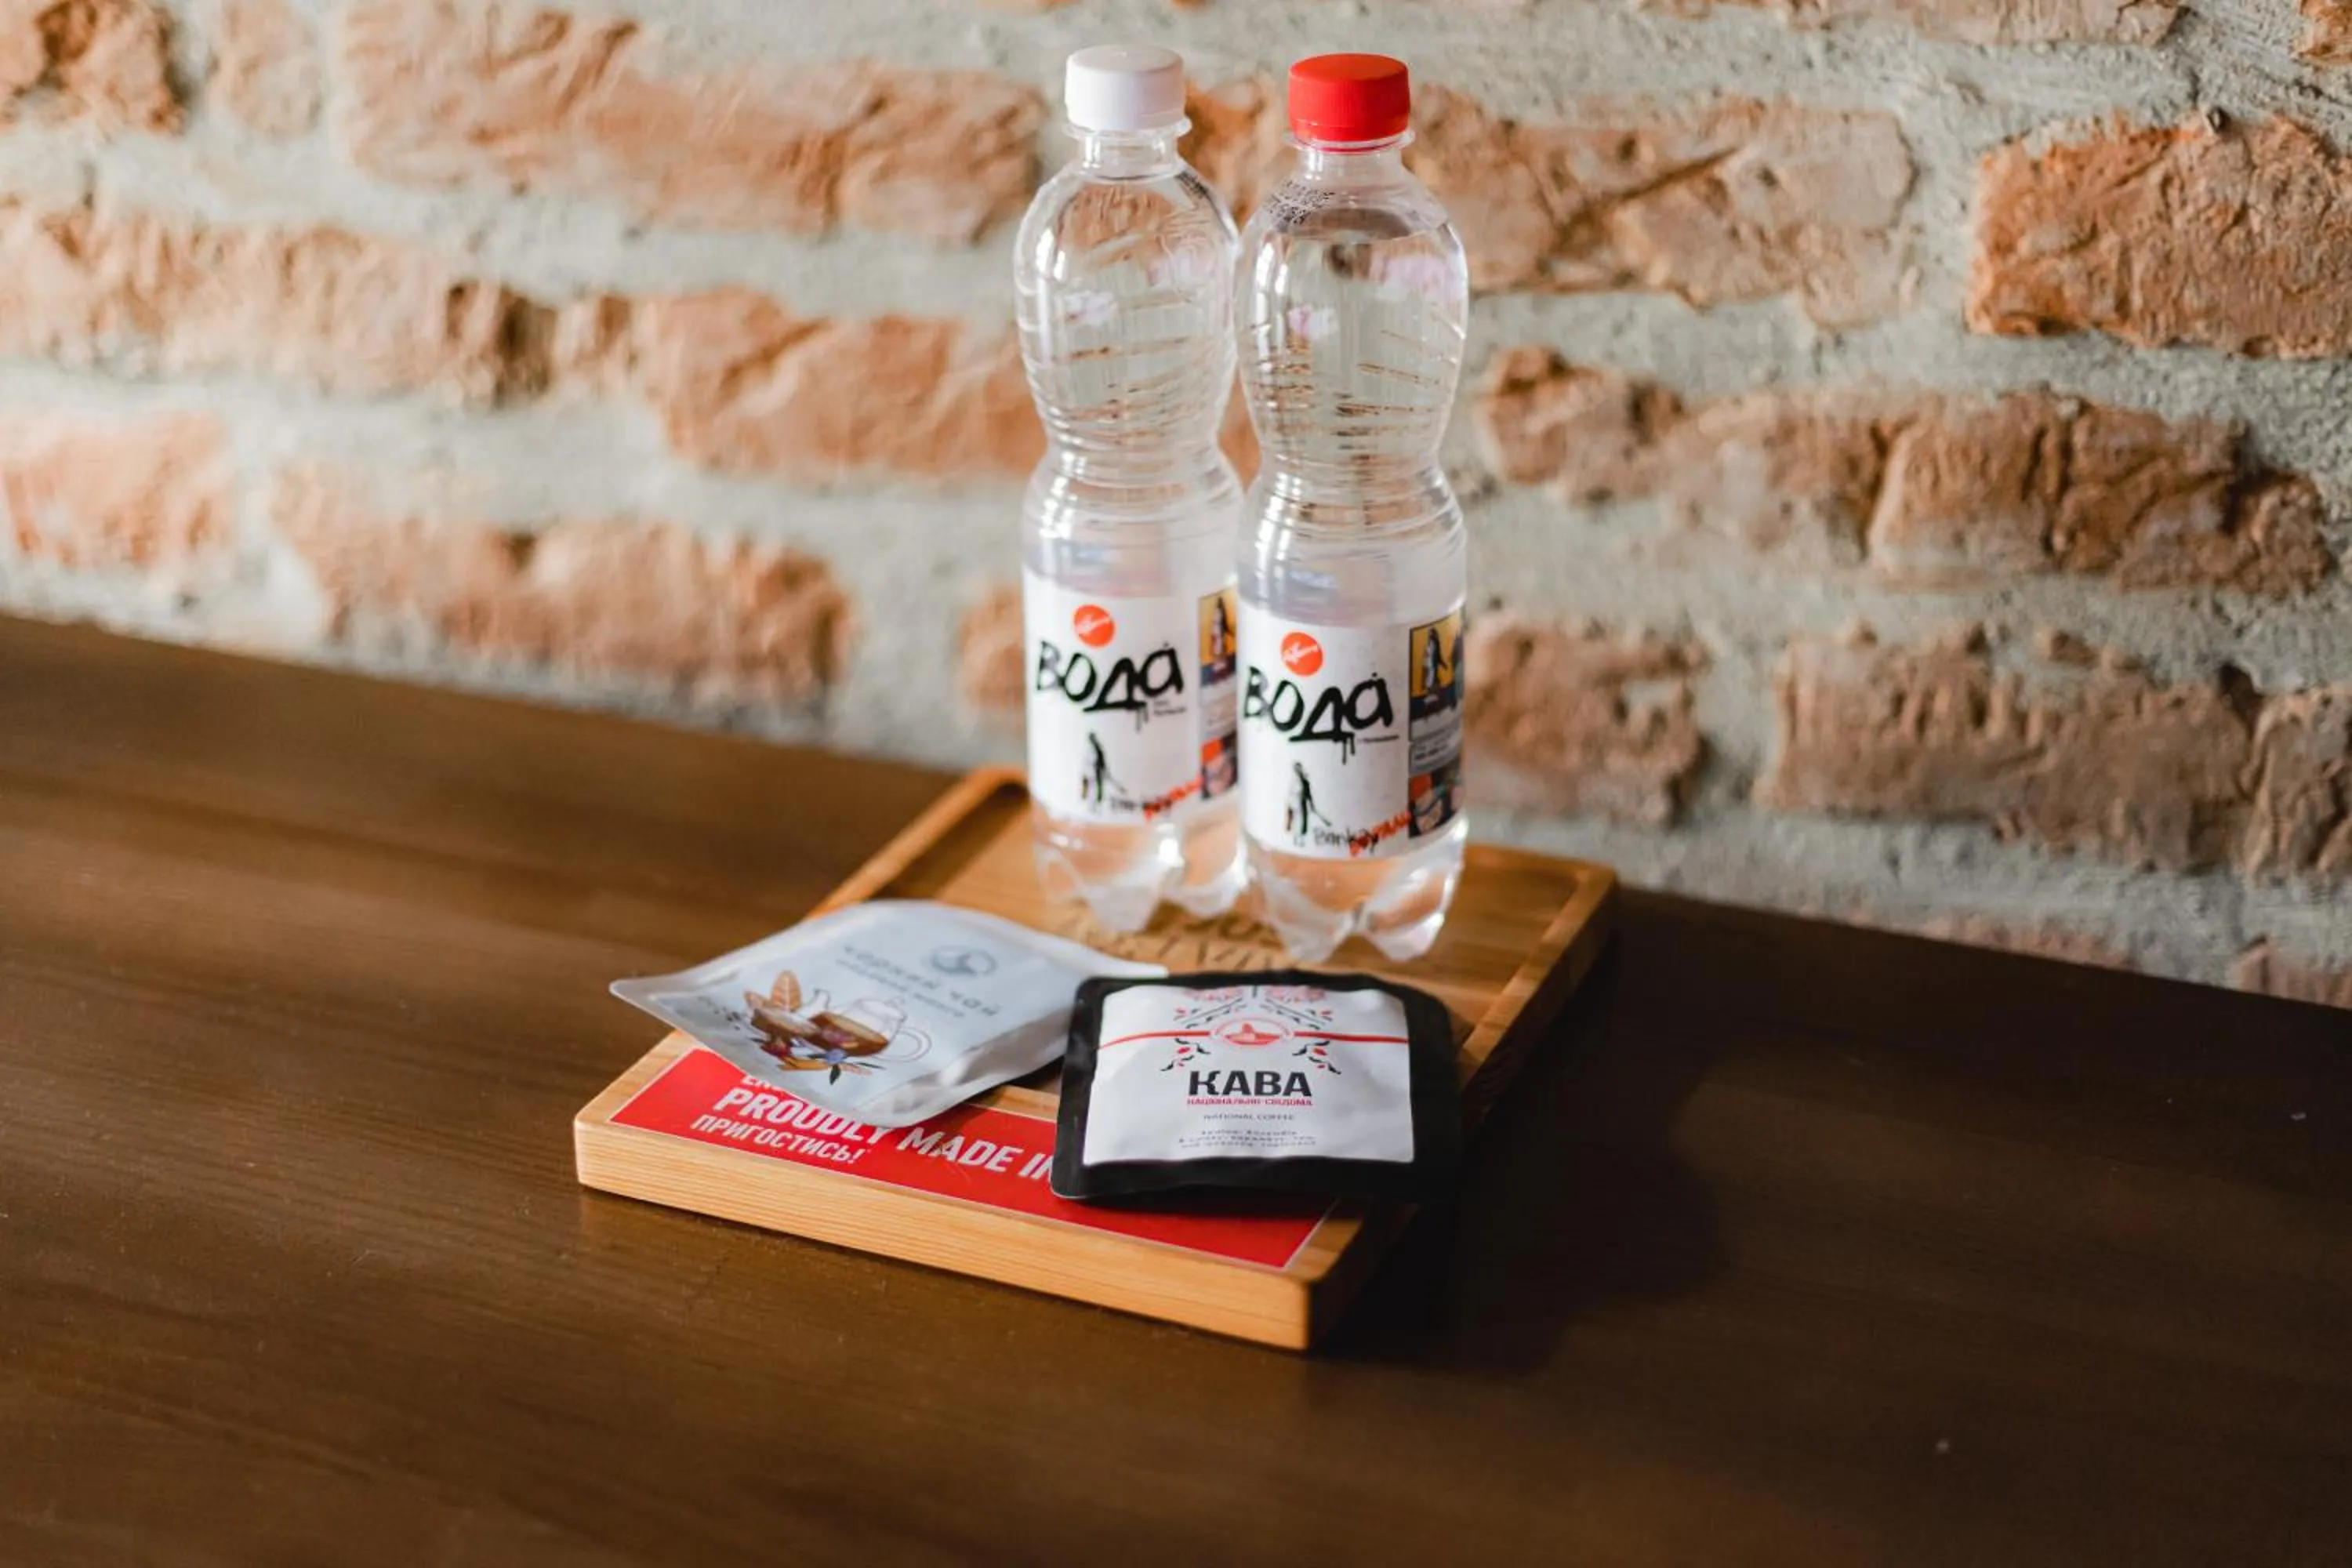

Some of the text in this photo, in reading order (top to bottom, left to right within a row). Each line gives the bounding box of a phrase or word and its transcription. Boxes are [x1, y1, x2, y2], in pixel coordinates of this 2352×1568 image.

[1188, 1070, 1313, 1098] КАВА
[691, 1113, 866, 1164] ПРИГОСТИСЬ!
[714, 1087, 893, 1145] PROUDLY
[896, 1126, 1025, 1174] MADE
